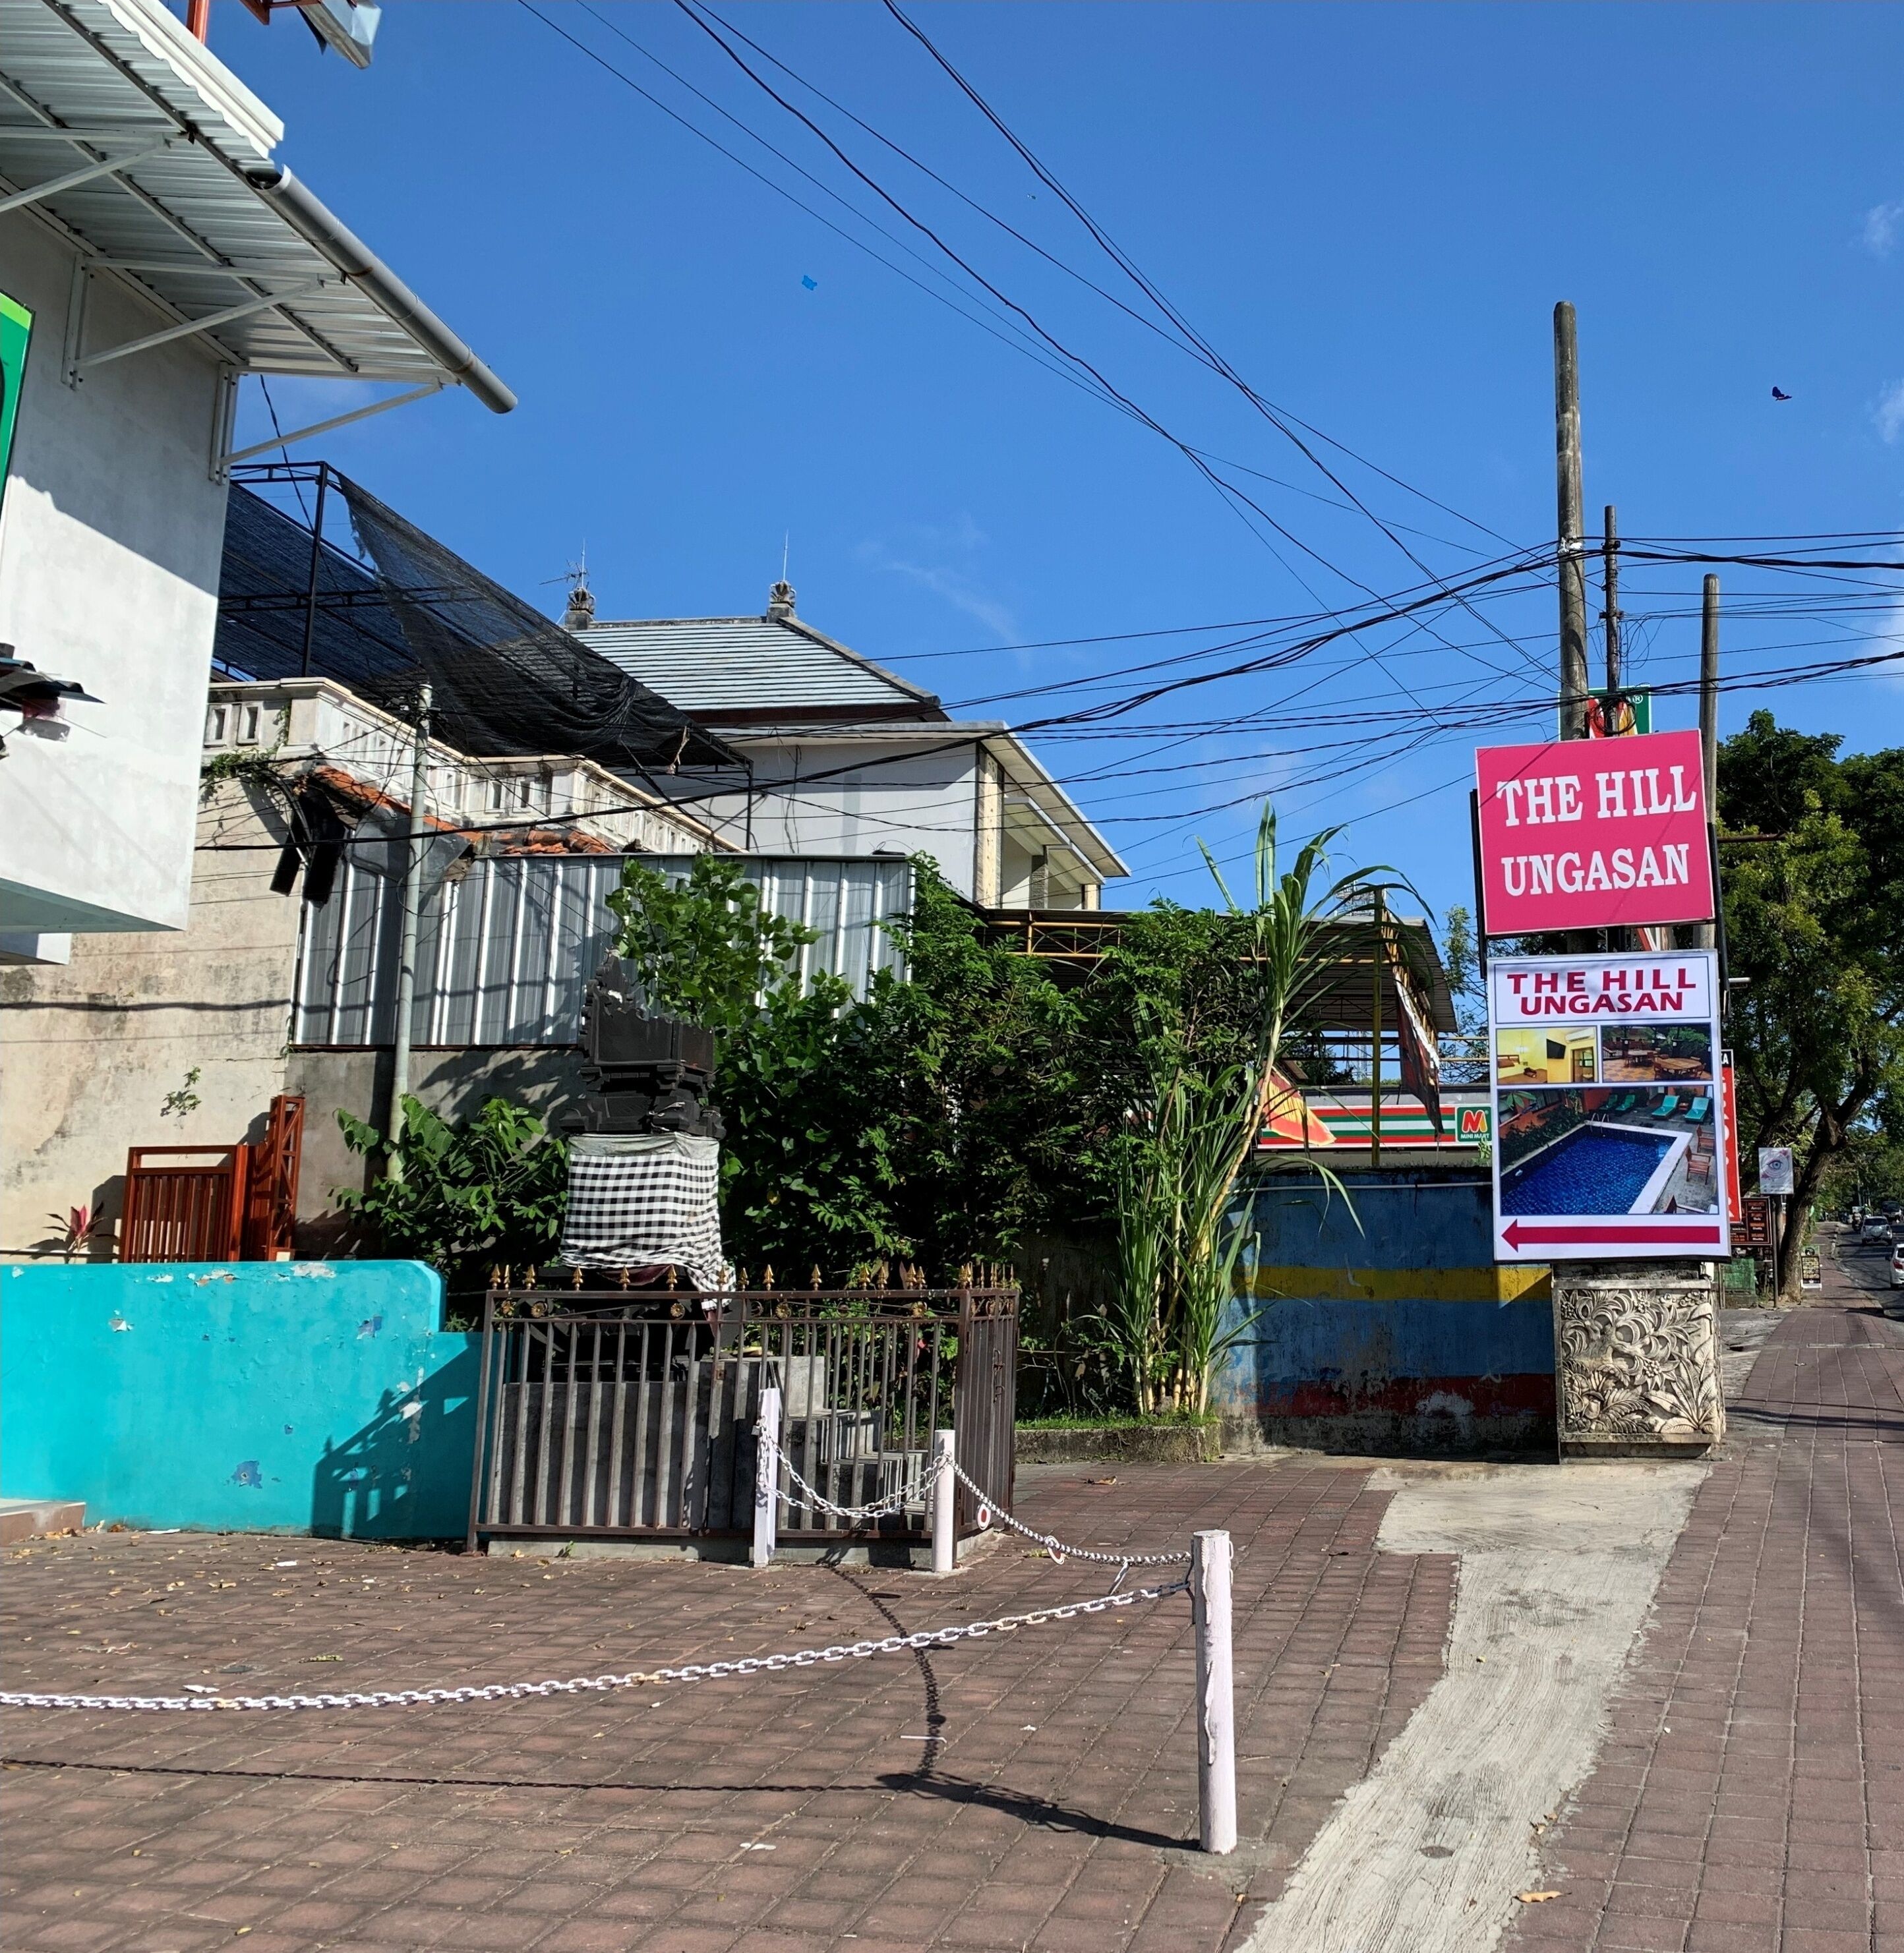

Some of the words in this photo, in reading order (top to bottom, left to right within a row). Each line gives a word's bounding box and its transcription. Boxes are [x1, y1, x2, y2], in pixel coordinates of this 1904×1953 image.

[1496, 774, 1583, 827] THE
[1595, 765, 1697, 819] HILL
[1501, 843, 1689, 896] UNGASAN
[1506, 972, 1586, 994] THE
[1602, 968, 1696, 991] HILL
[1520, 991, 1682, 1015] UNGASAN
